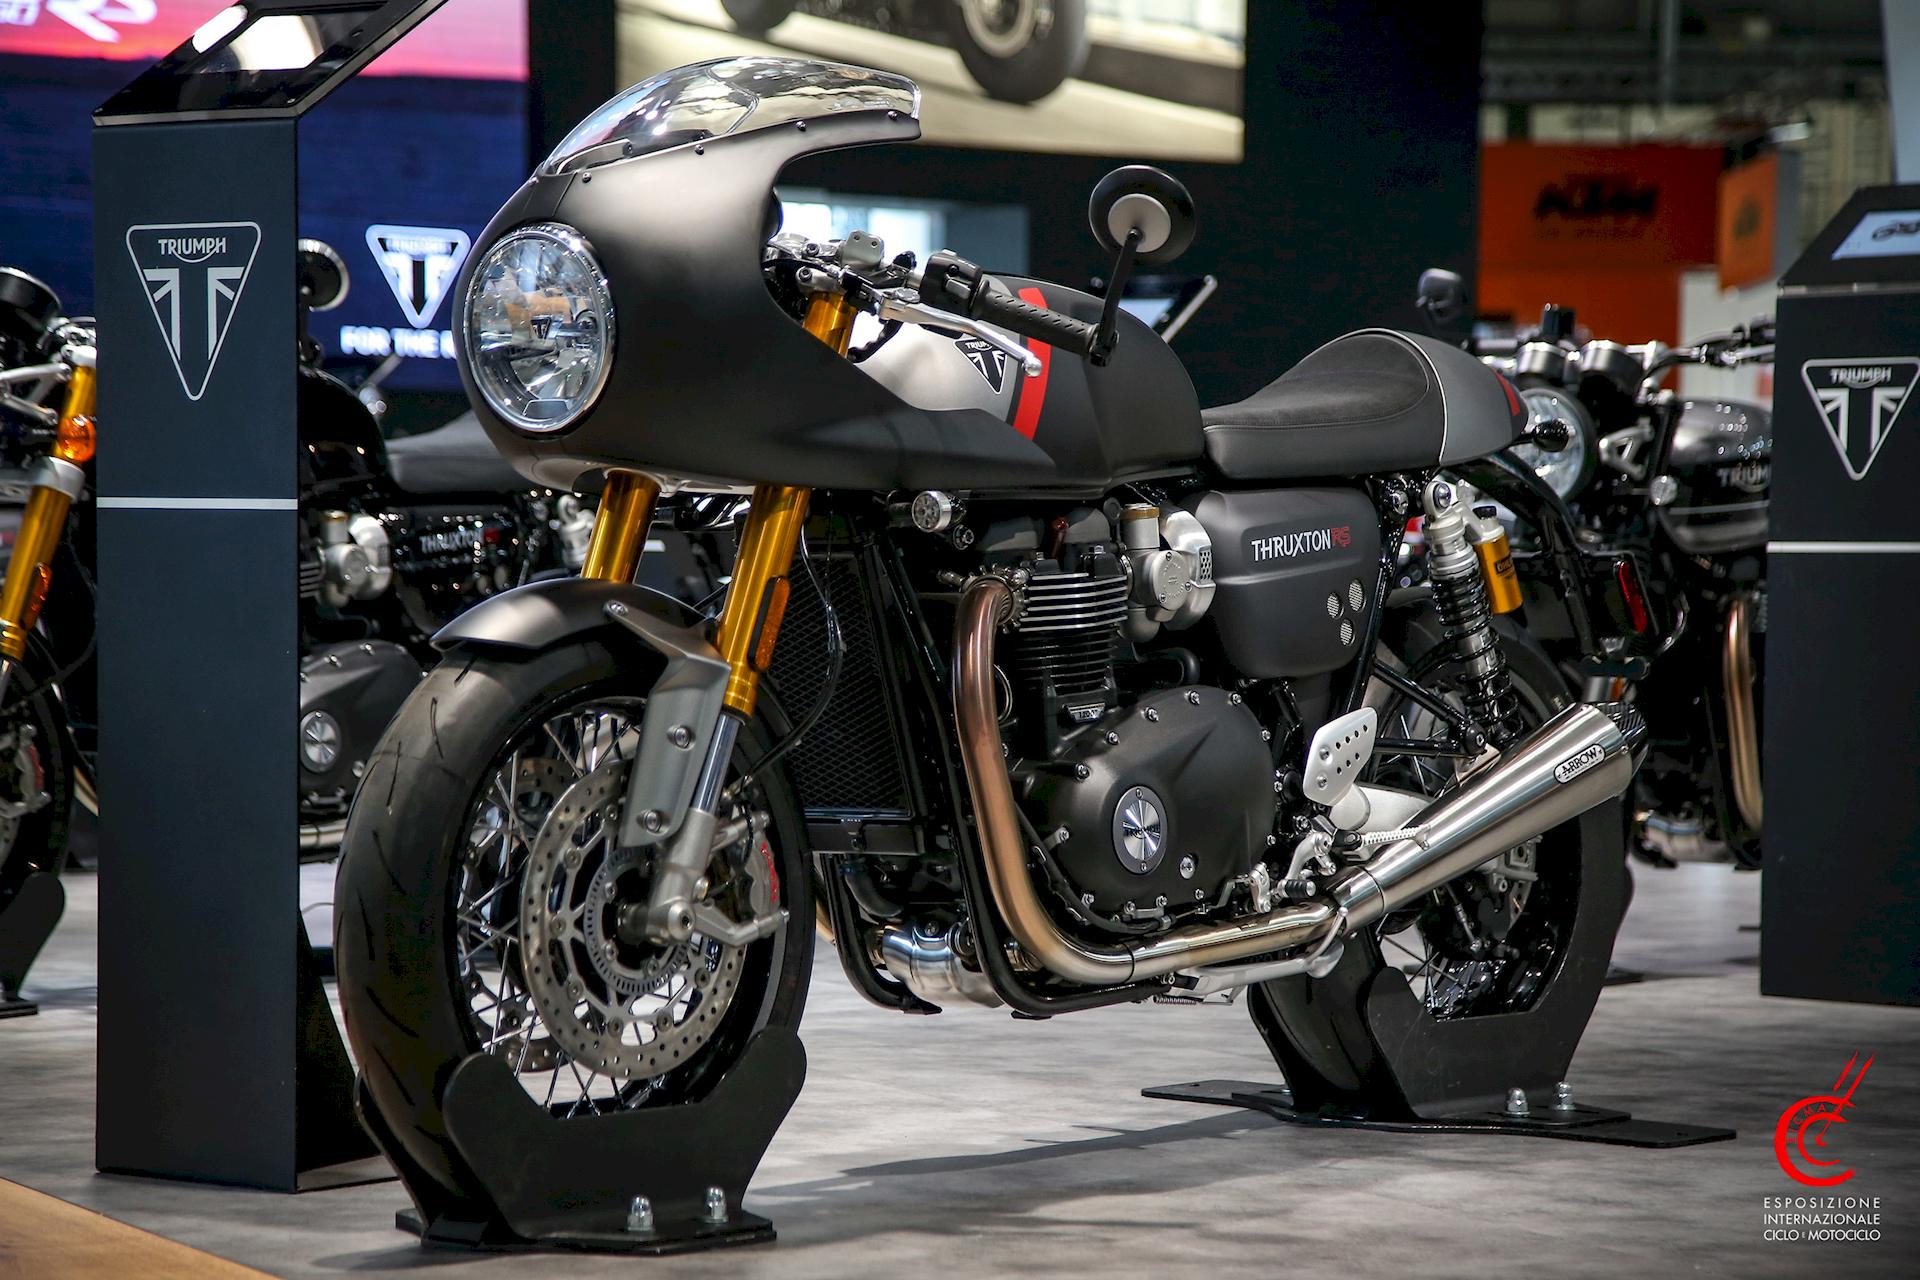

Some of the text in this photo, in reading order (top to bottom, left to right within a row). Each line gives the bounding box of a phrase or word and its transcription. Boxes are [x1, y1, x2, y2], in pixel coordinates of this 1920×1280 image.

[158, 237, 227, 261] TRIUMPH
[1830, 367, 1892, 387] TRIUMPH
[1251, 526, 1352, 561] THRUXTON RS
[1562, 747, 1597, 776] ARROW
